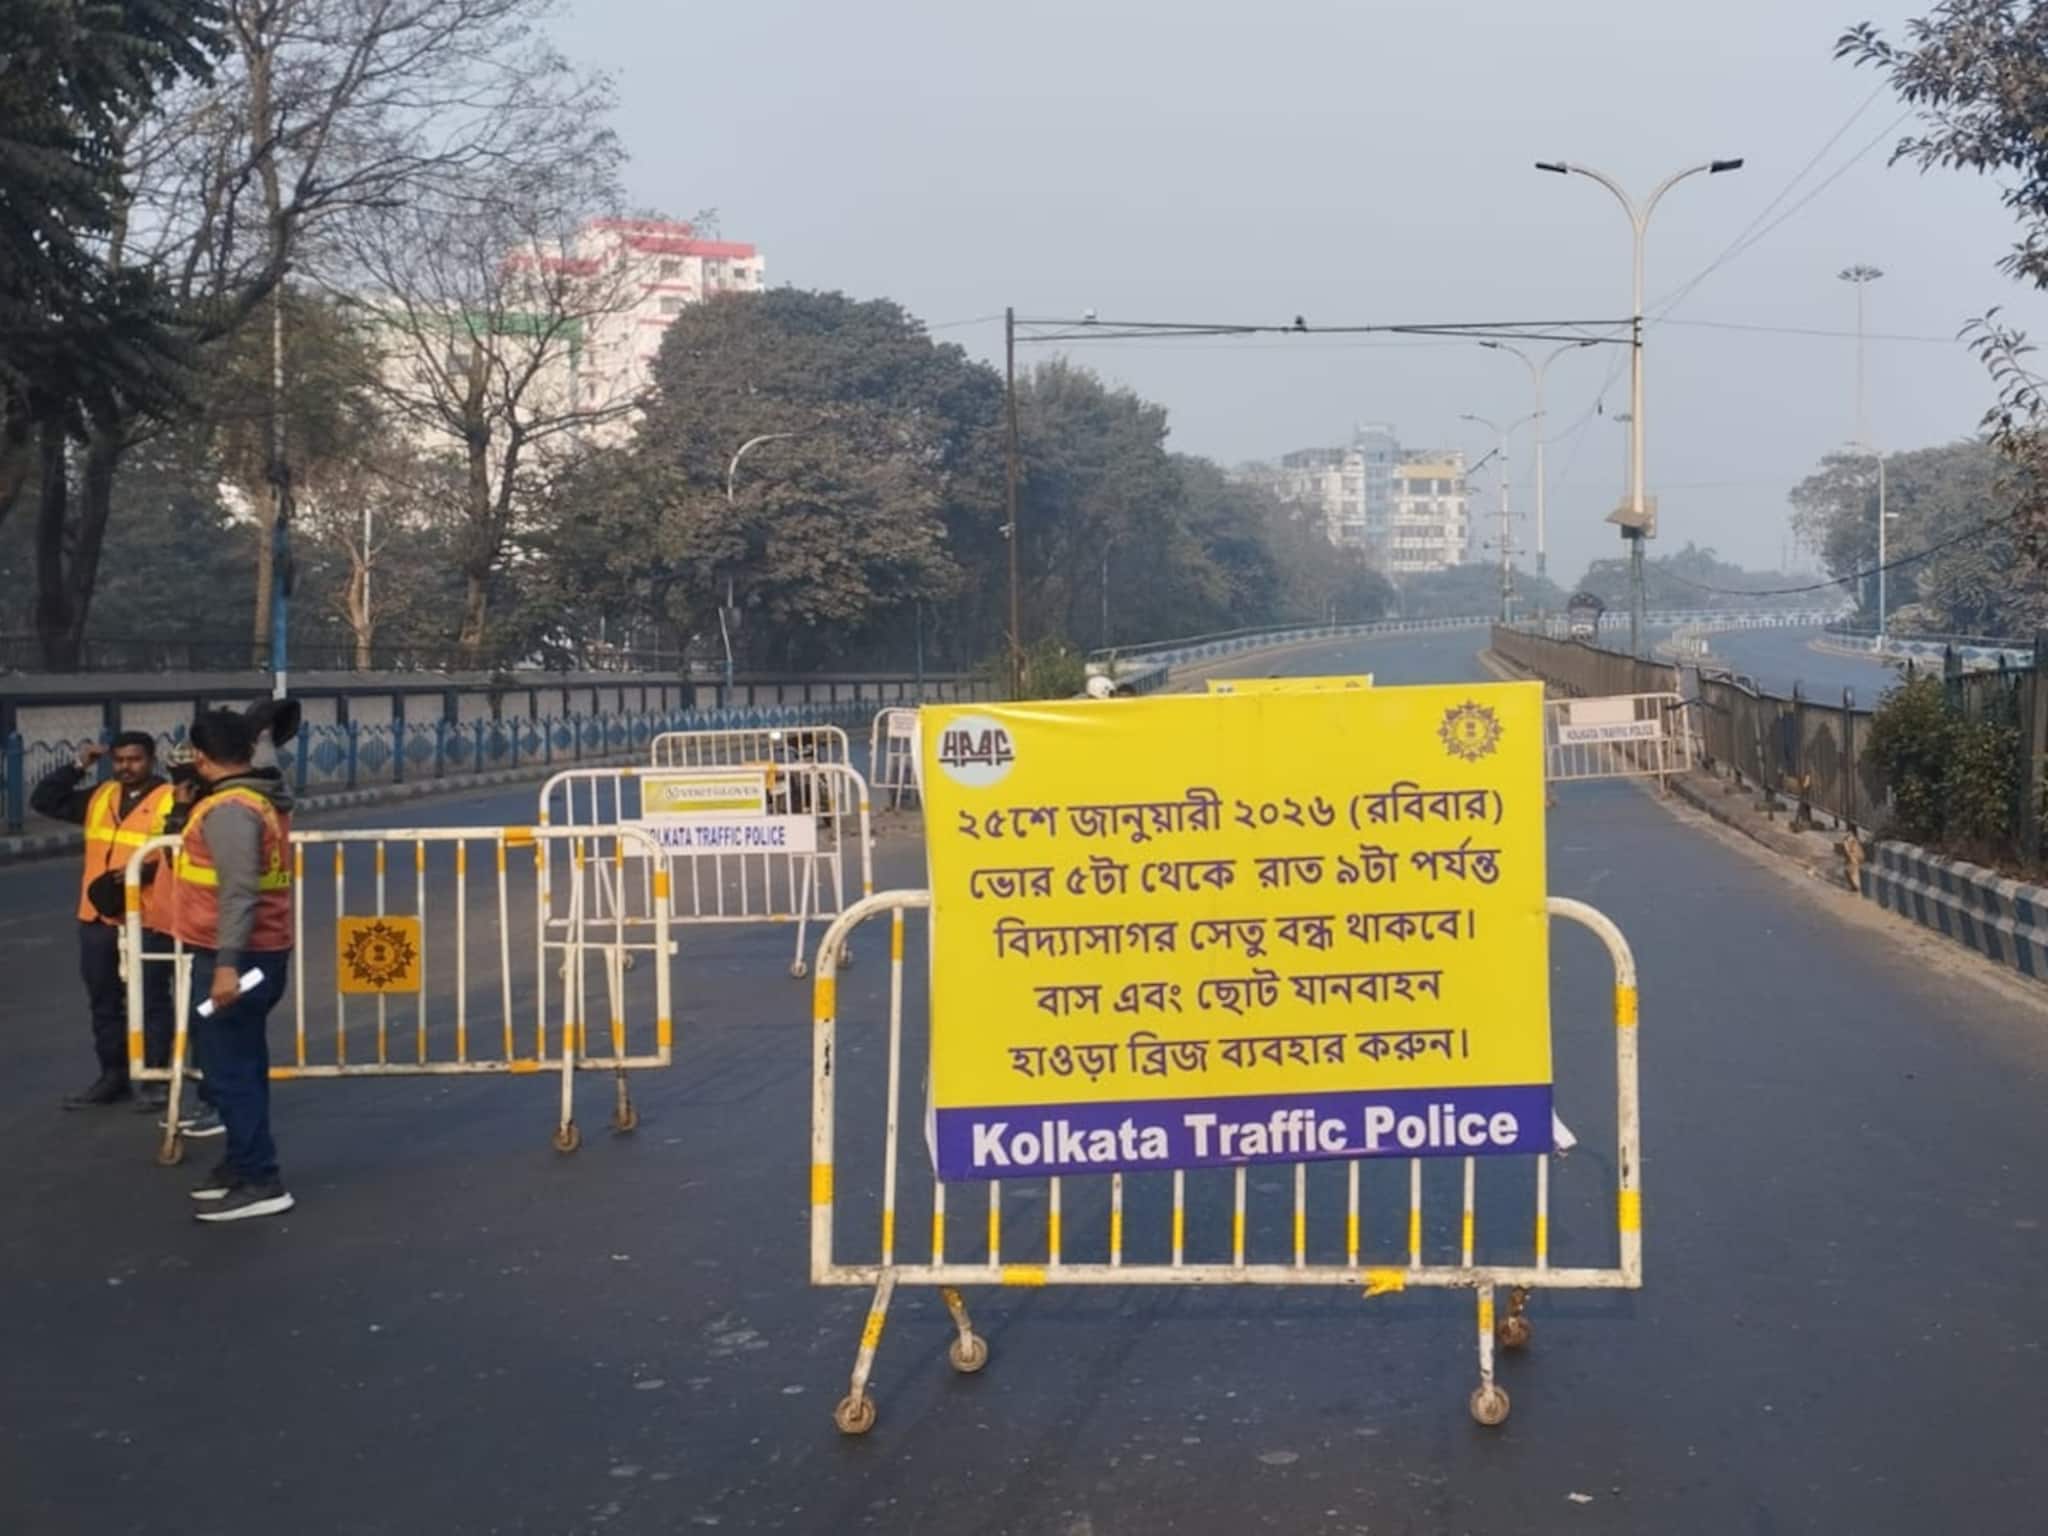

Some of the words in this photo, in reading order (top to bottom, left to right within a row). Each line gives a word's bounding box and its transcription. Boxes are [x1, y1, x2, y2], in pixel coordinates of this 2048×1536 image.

[644, 827, 692, 847] OLKATA
[696, 826, 742, 846] TRAFFIC
[745, 825, 785, 846] POLICE
[959, 806, 1059, 839] ২৫শে
[1067, 787, 1223, 843] জানুয়ারী
[1235, 797, 1335, 829] ২০২৬
[1350, 781, 1503, 831] (রবিবার)
[970, 866, 1055, 899] ভোর
[1066, 855, 1129, 895] ৫টা
[1141, 860, 1236, 893] থেকে
[1254, 855, 1325, 888] রাত
[1336, 844, 1399, 884] ৯টা
[1410, 836, 1502, 885] পর্যন্ত
[993, 917, 1179, 958] বিদ্যাসাগর
[1190, 918, 1267, 958] সেতু
[1273, 914, 1336, 952] বন্ধ
[1346, 909, 1475, 944] থাকবে।
[1033, 985, 1103, 1017] বাস
[1113, 981, 1183, 1015] এবং
[1198, 967, 1280, 1016] ছোট
[1288, 970, 1443, 1005] যানবাহন
[1008, 1044, 1119, 1083] হাওড়া
[1126, 1031, 1210, 1077] ব্রিজ
[1218, 1034, 1347, 1069] ব্যবহার
[1355, 1029, 1469, 1062] করুন।
[972, 1119, 1169, 1167] Kolkata
[1184, 1109, 1347, 1156] Traffic
[1366, 1104, 1518, 1150] Police
